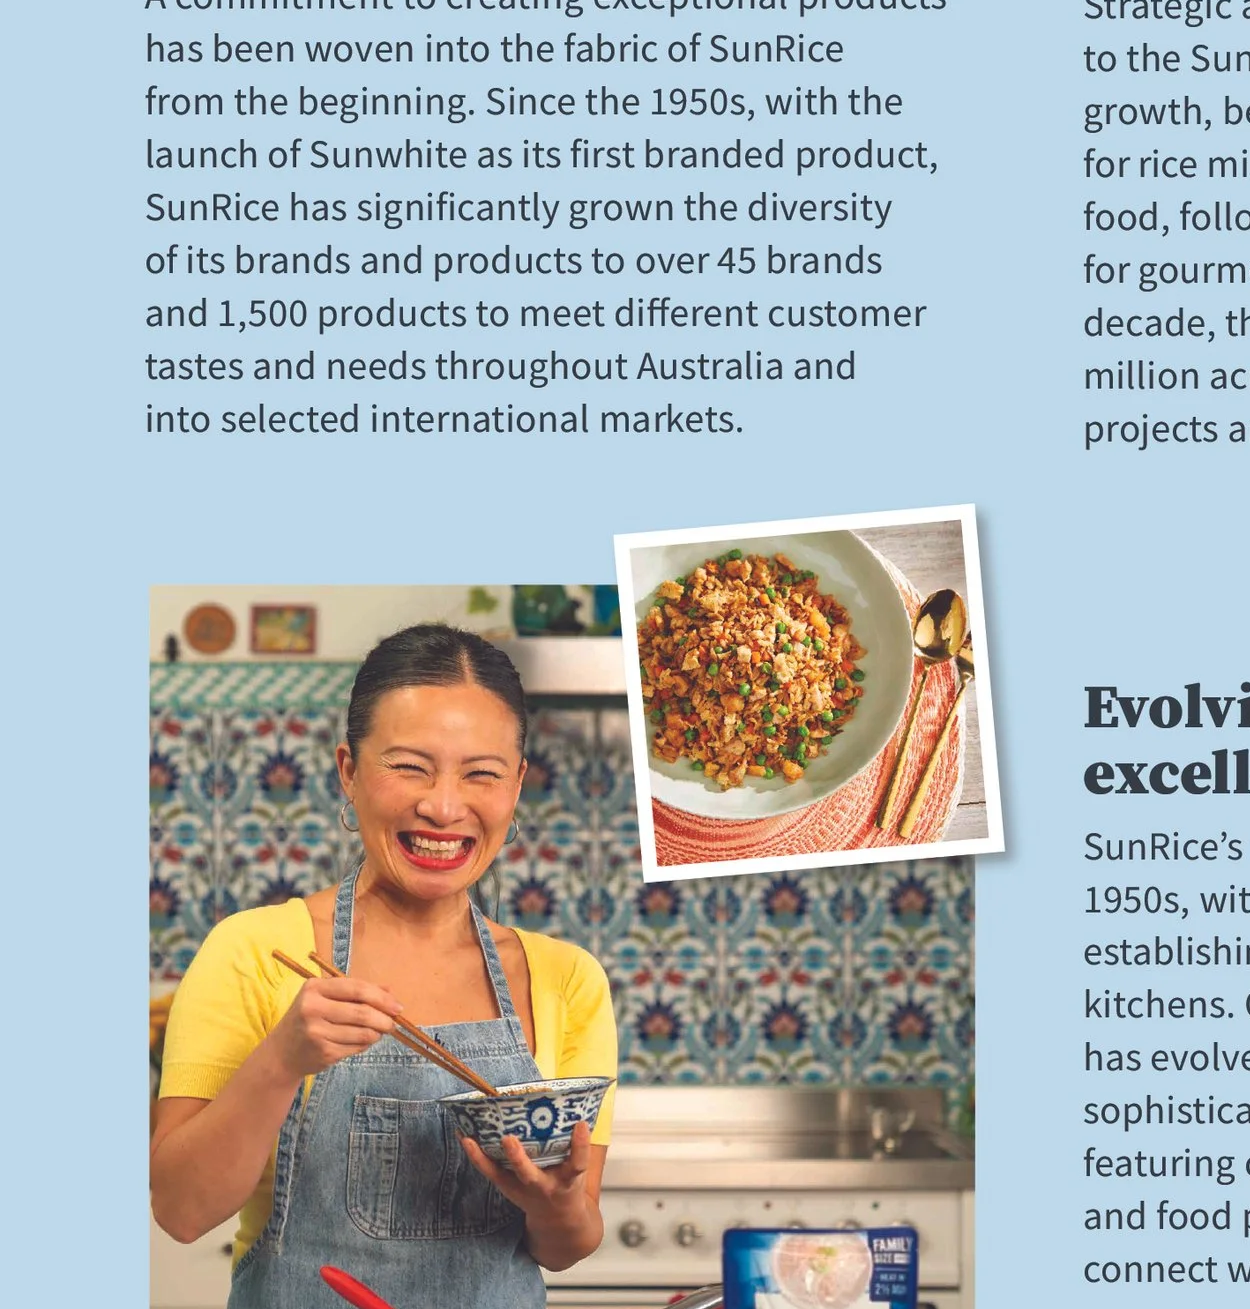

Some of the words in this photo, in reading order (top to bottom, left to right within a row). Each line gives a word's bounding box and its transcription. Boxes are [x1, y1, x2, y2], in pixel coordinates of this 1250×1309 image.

[146, 193, 279, 221] SunRice
[291, 192, 346, 221] has
[358, 191, 560, 229] significantly
[570, 200, 672, 229] grown
[684, 192, 737, 221] the
[749, 192, 892, 229] diversity
